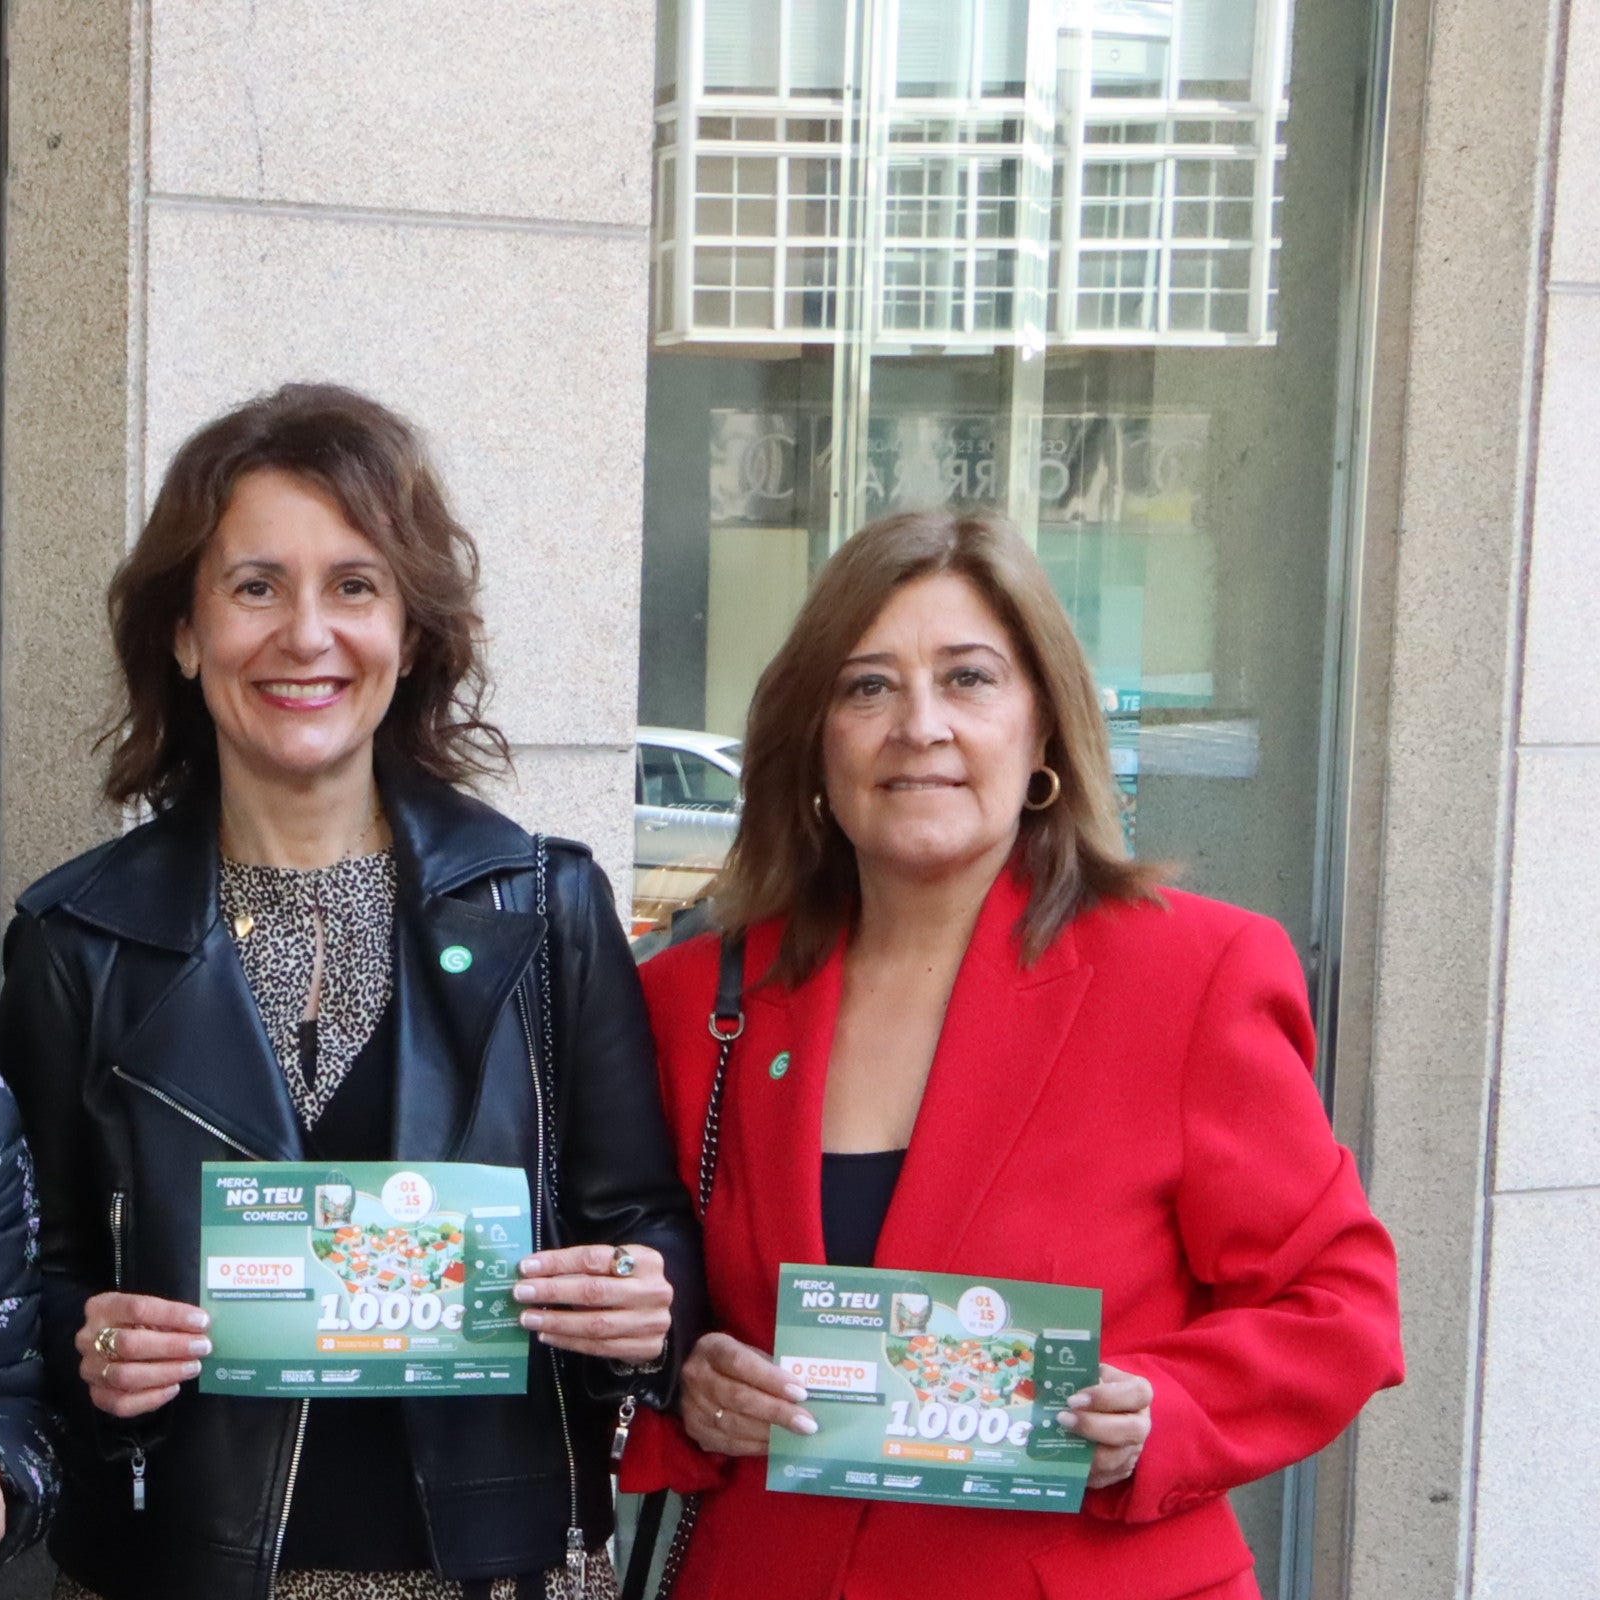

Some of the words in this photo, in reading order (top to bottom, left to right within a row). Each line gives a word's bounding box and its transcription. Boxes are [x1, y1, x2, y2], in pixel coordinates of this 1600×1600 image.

[217, 1177, 258, 1188] MERCA
[401, 1181, 417, 1192] 01
[226, 1188, 258, 1206] NO
[263, 1187, 303, 1204] TEU
[405, 1196, 420, 1206] 15
[243, 1211, 308, 1222] COMERCIO
[220, 1264, 231, 1276] O
[236, 1264, 293, 1276] COUTO
[793, 1279, 835, 1291] MERCA
[802, 1292, 835, 1307] NO
[839, 1292, 879, 1309] TEU
[976, 1295, 991, 1307] 01
[317, 1293, 466, 1331] 1.000€
[980, 1310, 995, 1321] 15
[817, 1314, 884, 1327] COMERCIO
[322, 1338, 335, 1349] 20
[792, 1363, 803, 1375] O
[808, 1365, 865, 1380] COUTO
[886, 1401, 1033, 1446] 1.000€
